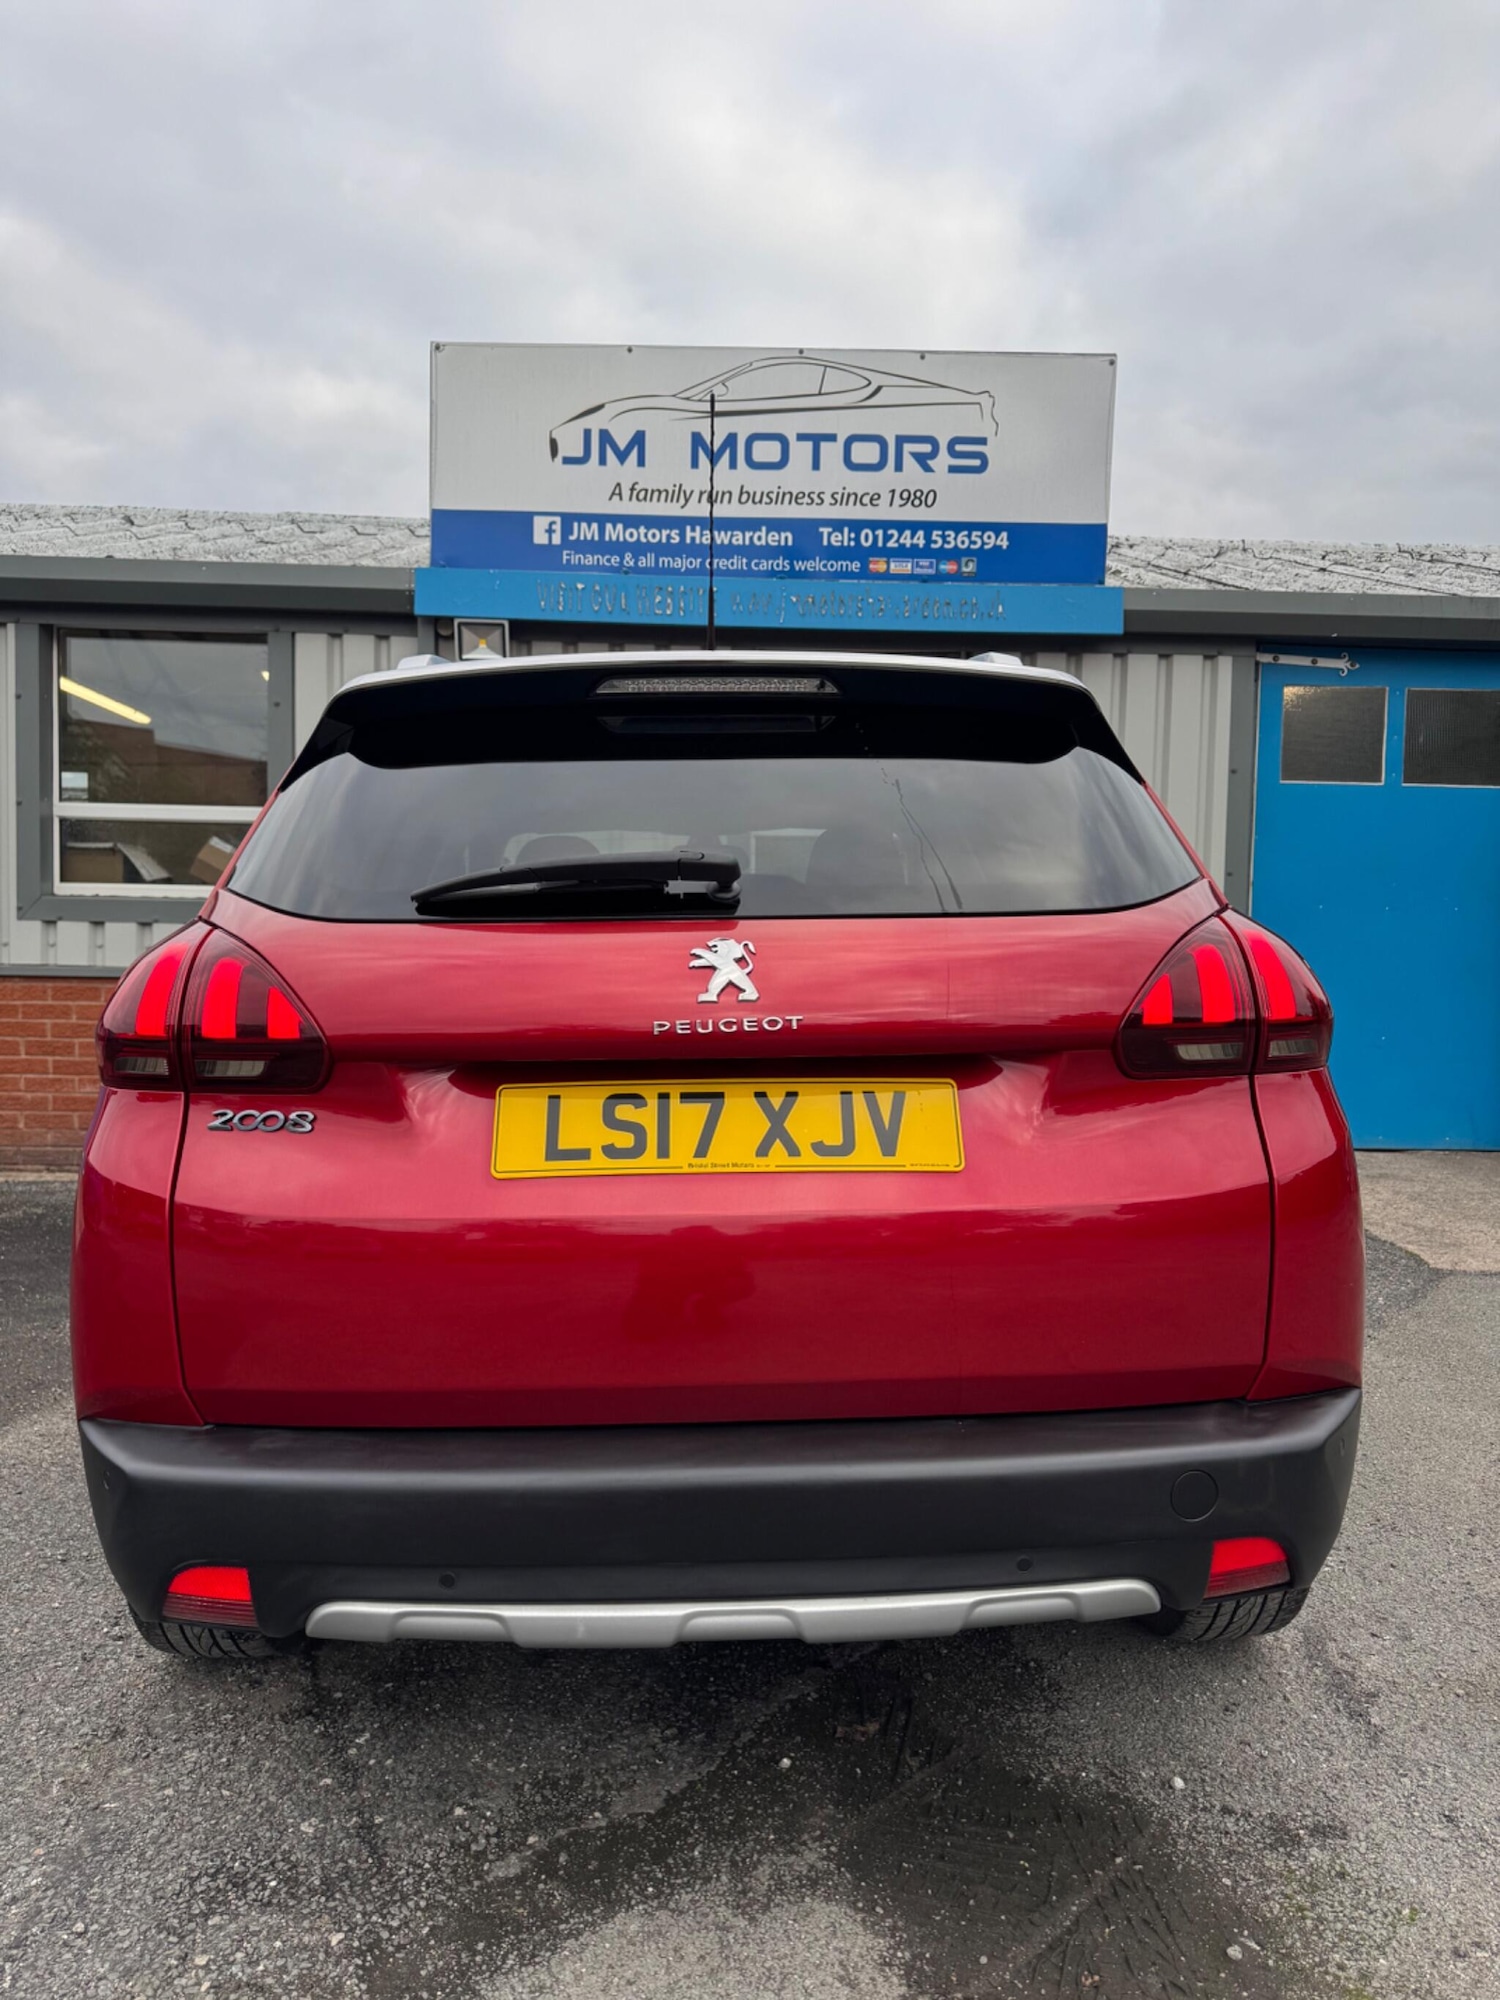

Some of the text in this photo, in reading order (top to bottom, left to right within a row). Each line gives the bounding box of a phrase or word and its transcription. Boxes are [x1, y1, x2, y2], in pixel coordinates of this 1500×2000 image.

[562, 428, 989, 475] JM MOTORS
[608, 481, 937, 509] A family run business since 1980
[568, 522, 599, 541] JM
[604, 523, 680, 544] Motors
[685, 525, 793, 546] Hawarden
[819, 527, 1009, 549] Tel: 01244 536594
[562, 550, 861, 573] Finance & all major credit cards welcome
[653, 1016, 803, 1035] PEUGEOT
[207, 1109, 315, 1133] 2008
[544, 1090, 906, 1162] LS17 XJV
